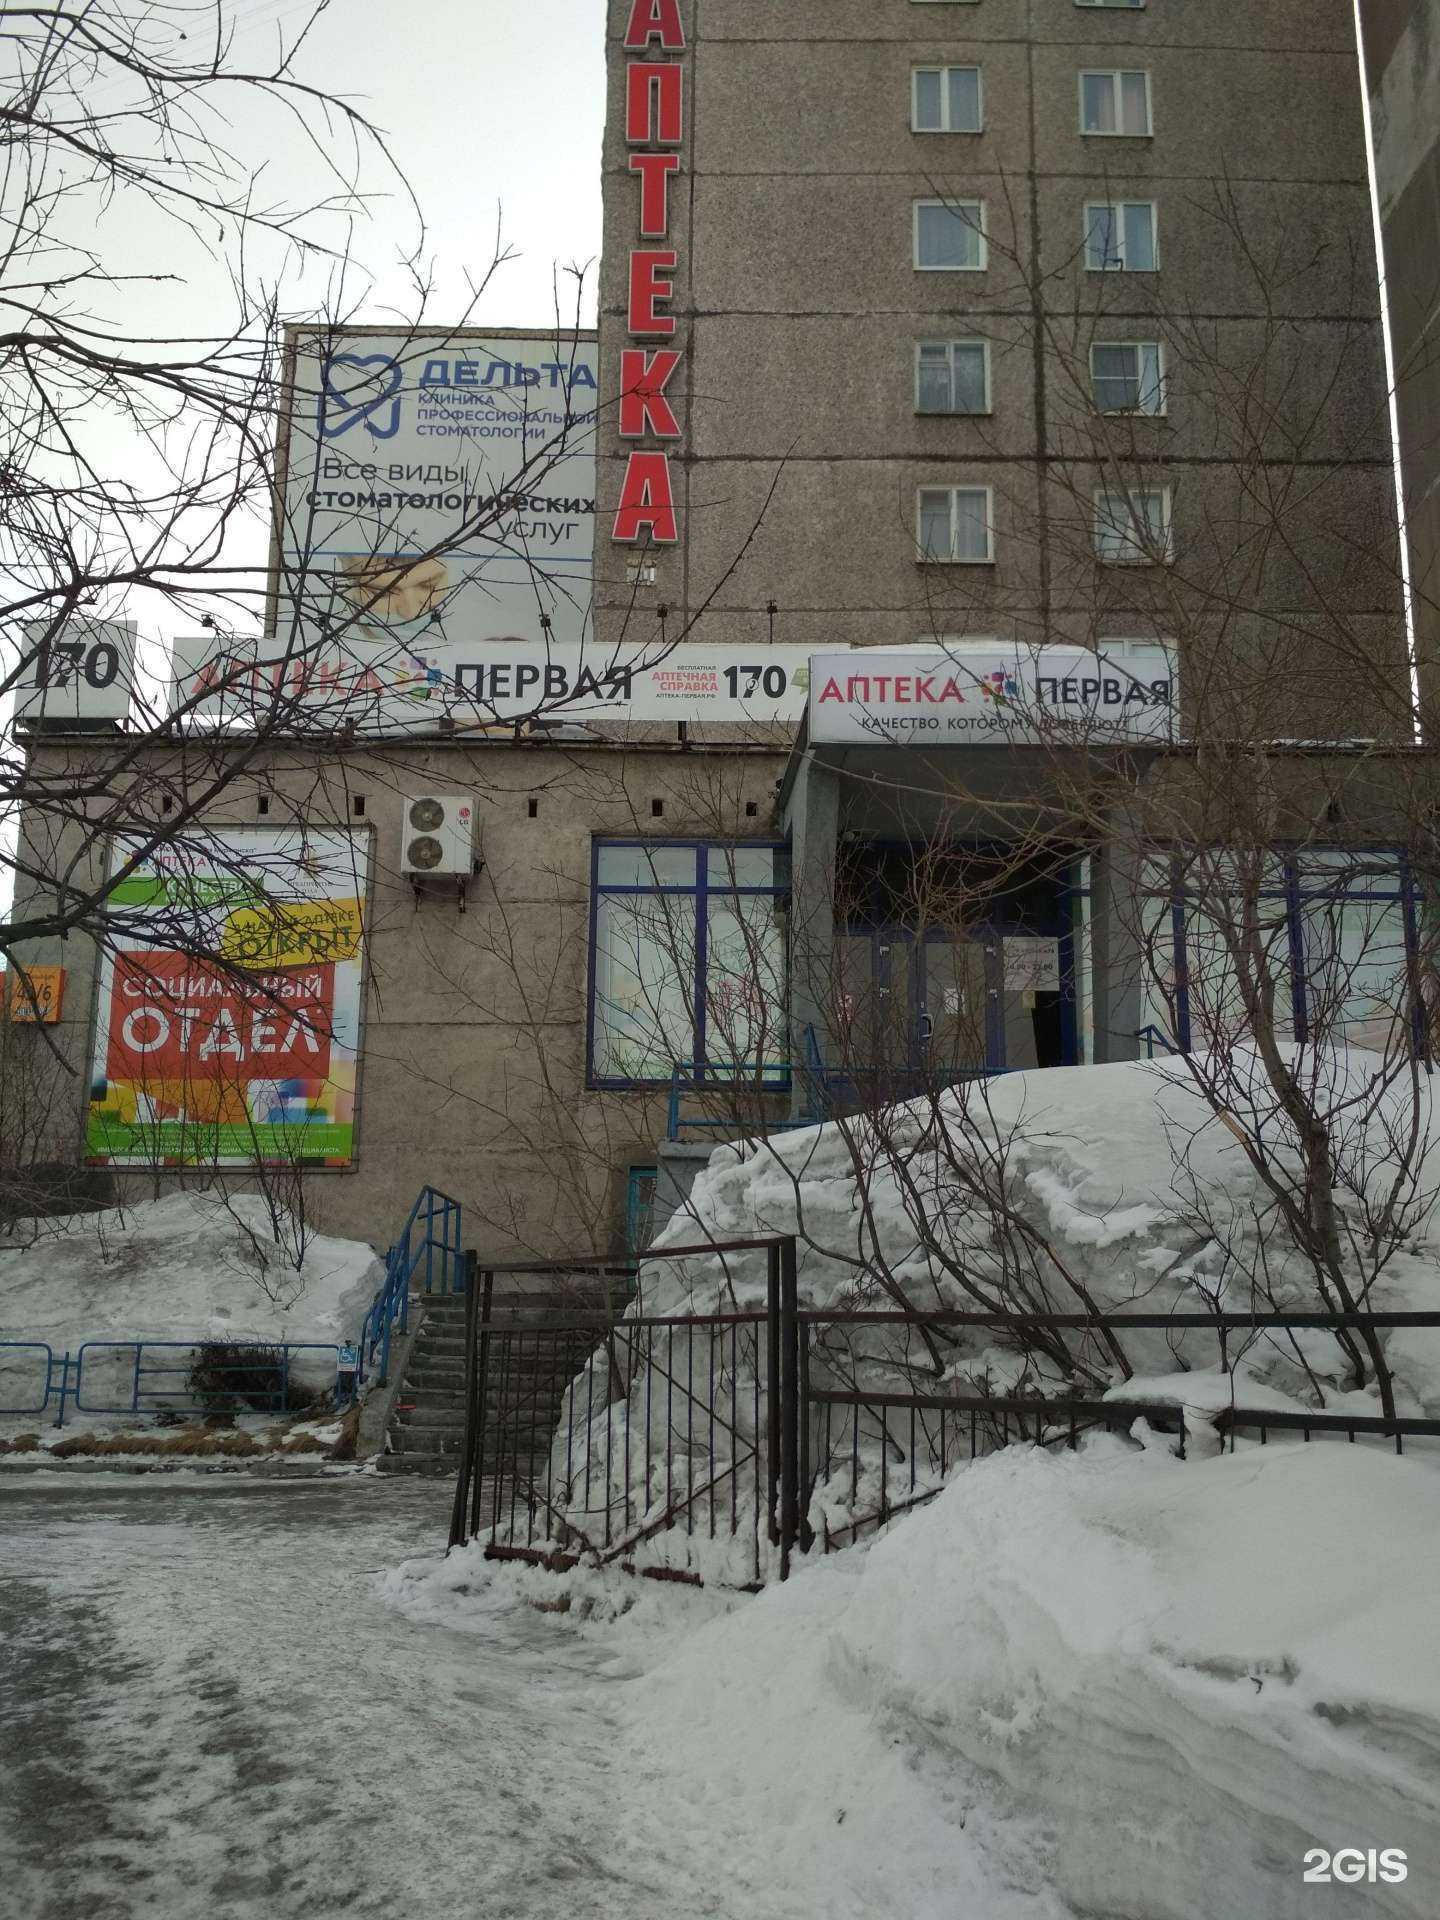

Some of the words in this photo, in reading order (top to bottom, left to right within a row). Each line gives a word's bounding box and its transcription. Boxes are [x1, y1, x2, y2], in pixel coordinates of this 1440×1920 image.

[611, 0, 687, 545] АПТЕКА
[418, 359, 598, 389] ДЕЛЬТА
[418, 393, 496, 406] КЛИНИКА
[415, 424, 546, 440] СТОМАТОЛОГИИ
[323, 457, 377, 480] Все
[388, 464, 465, 485] виды
[305, 491, 596, 514] стоматологических
[497, 520, 580, 546] услуг
[35, 642, 119, 689] 170
[651, 671, 718, 682] АПТЕЧНАЯ
[454, 663, 632, 700] ПЕРВАЯ
[659, 681, 719, 692] СПРАВКА
[723, 665, 787, 699] 170
[818, 676, 967, 704] АПТЕКА
[1035, 677, 1170, 706] ПЕРВАЯ
[947, 717, 1034, 731] КОТОРОМУ
[122, 1006, 320, 1062] ОТДЕЛ
